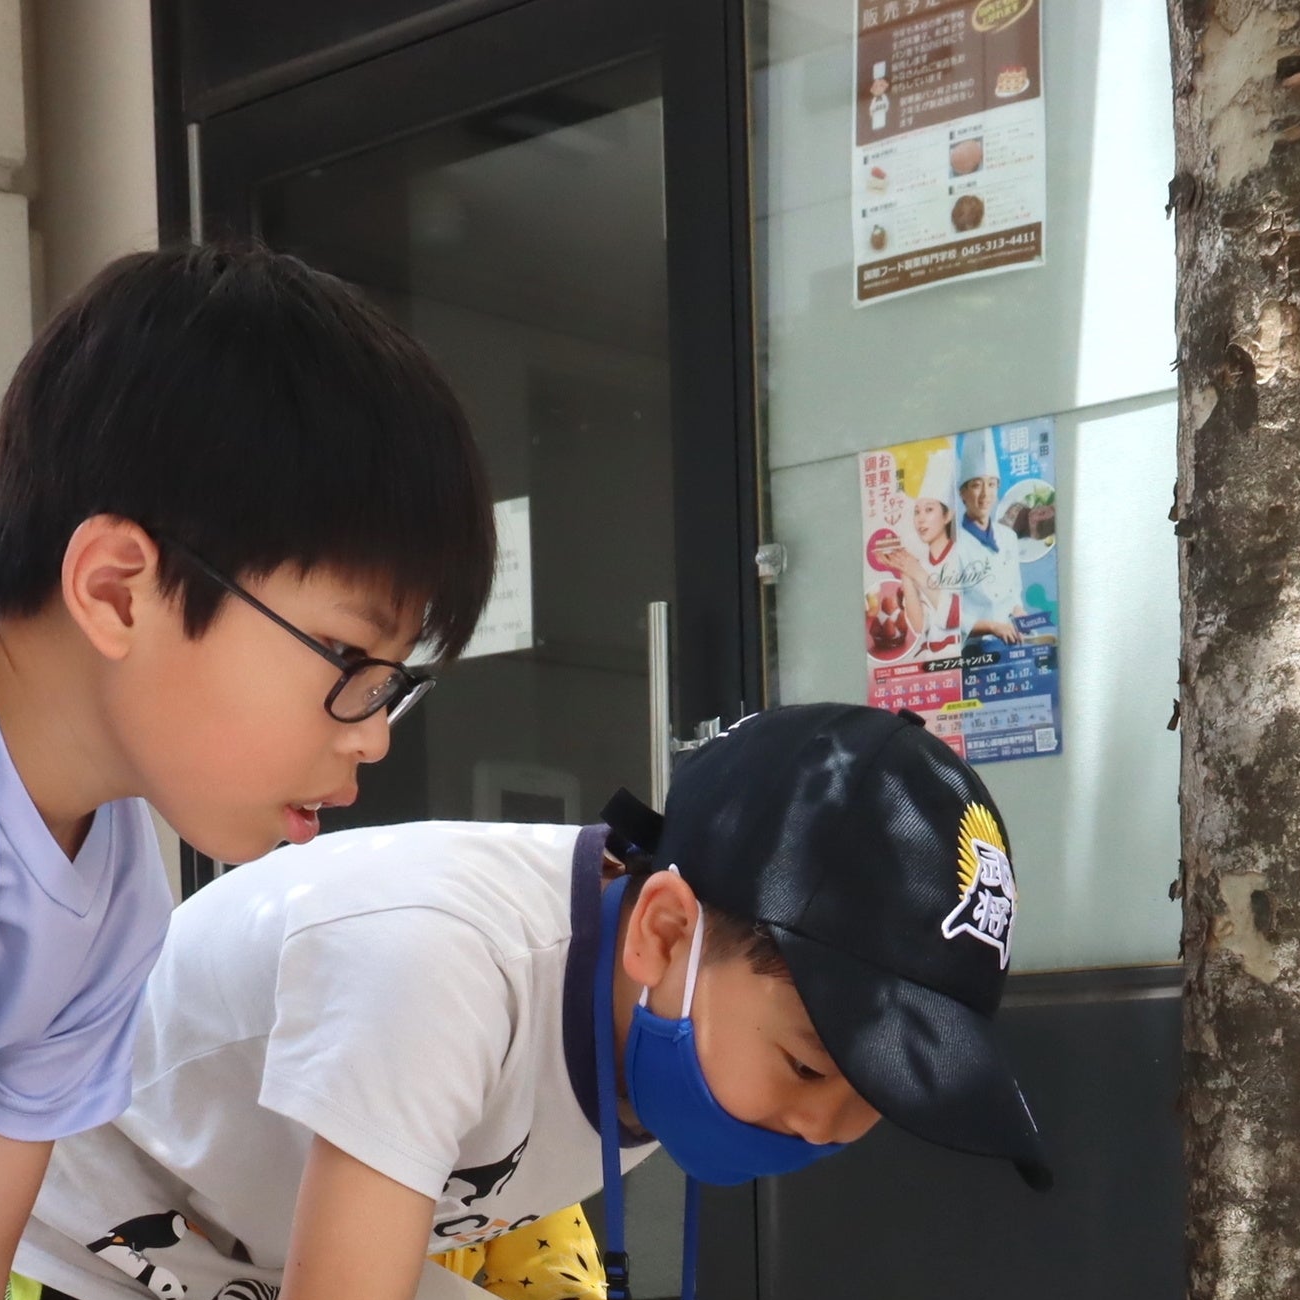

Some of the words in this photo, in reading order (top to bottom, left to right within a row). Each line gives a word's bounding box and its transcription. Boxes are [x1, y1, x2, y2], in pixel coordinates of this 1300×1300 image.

[961, 231, 1036, 257] 045-313-4411
[928, 654, 993, 671] オープンキャンパス
